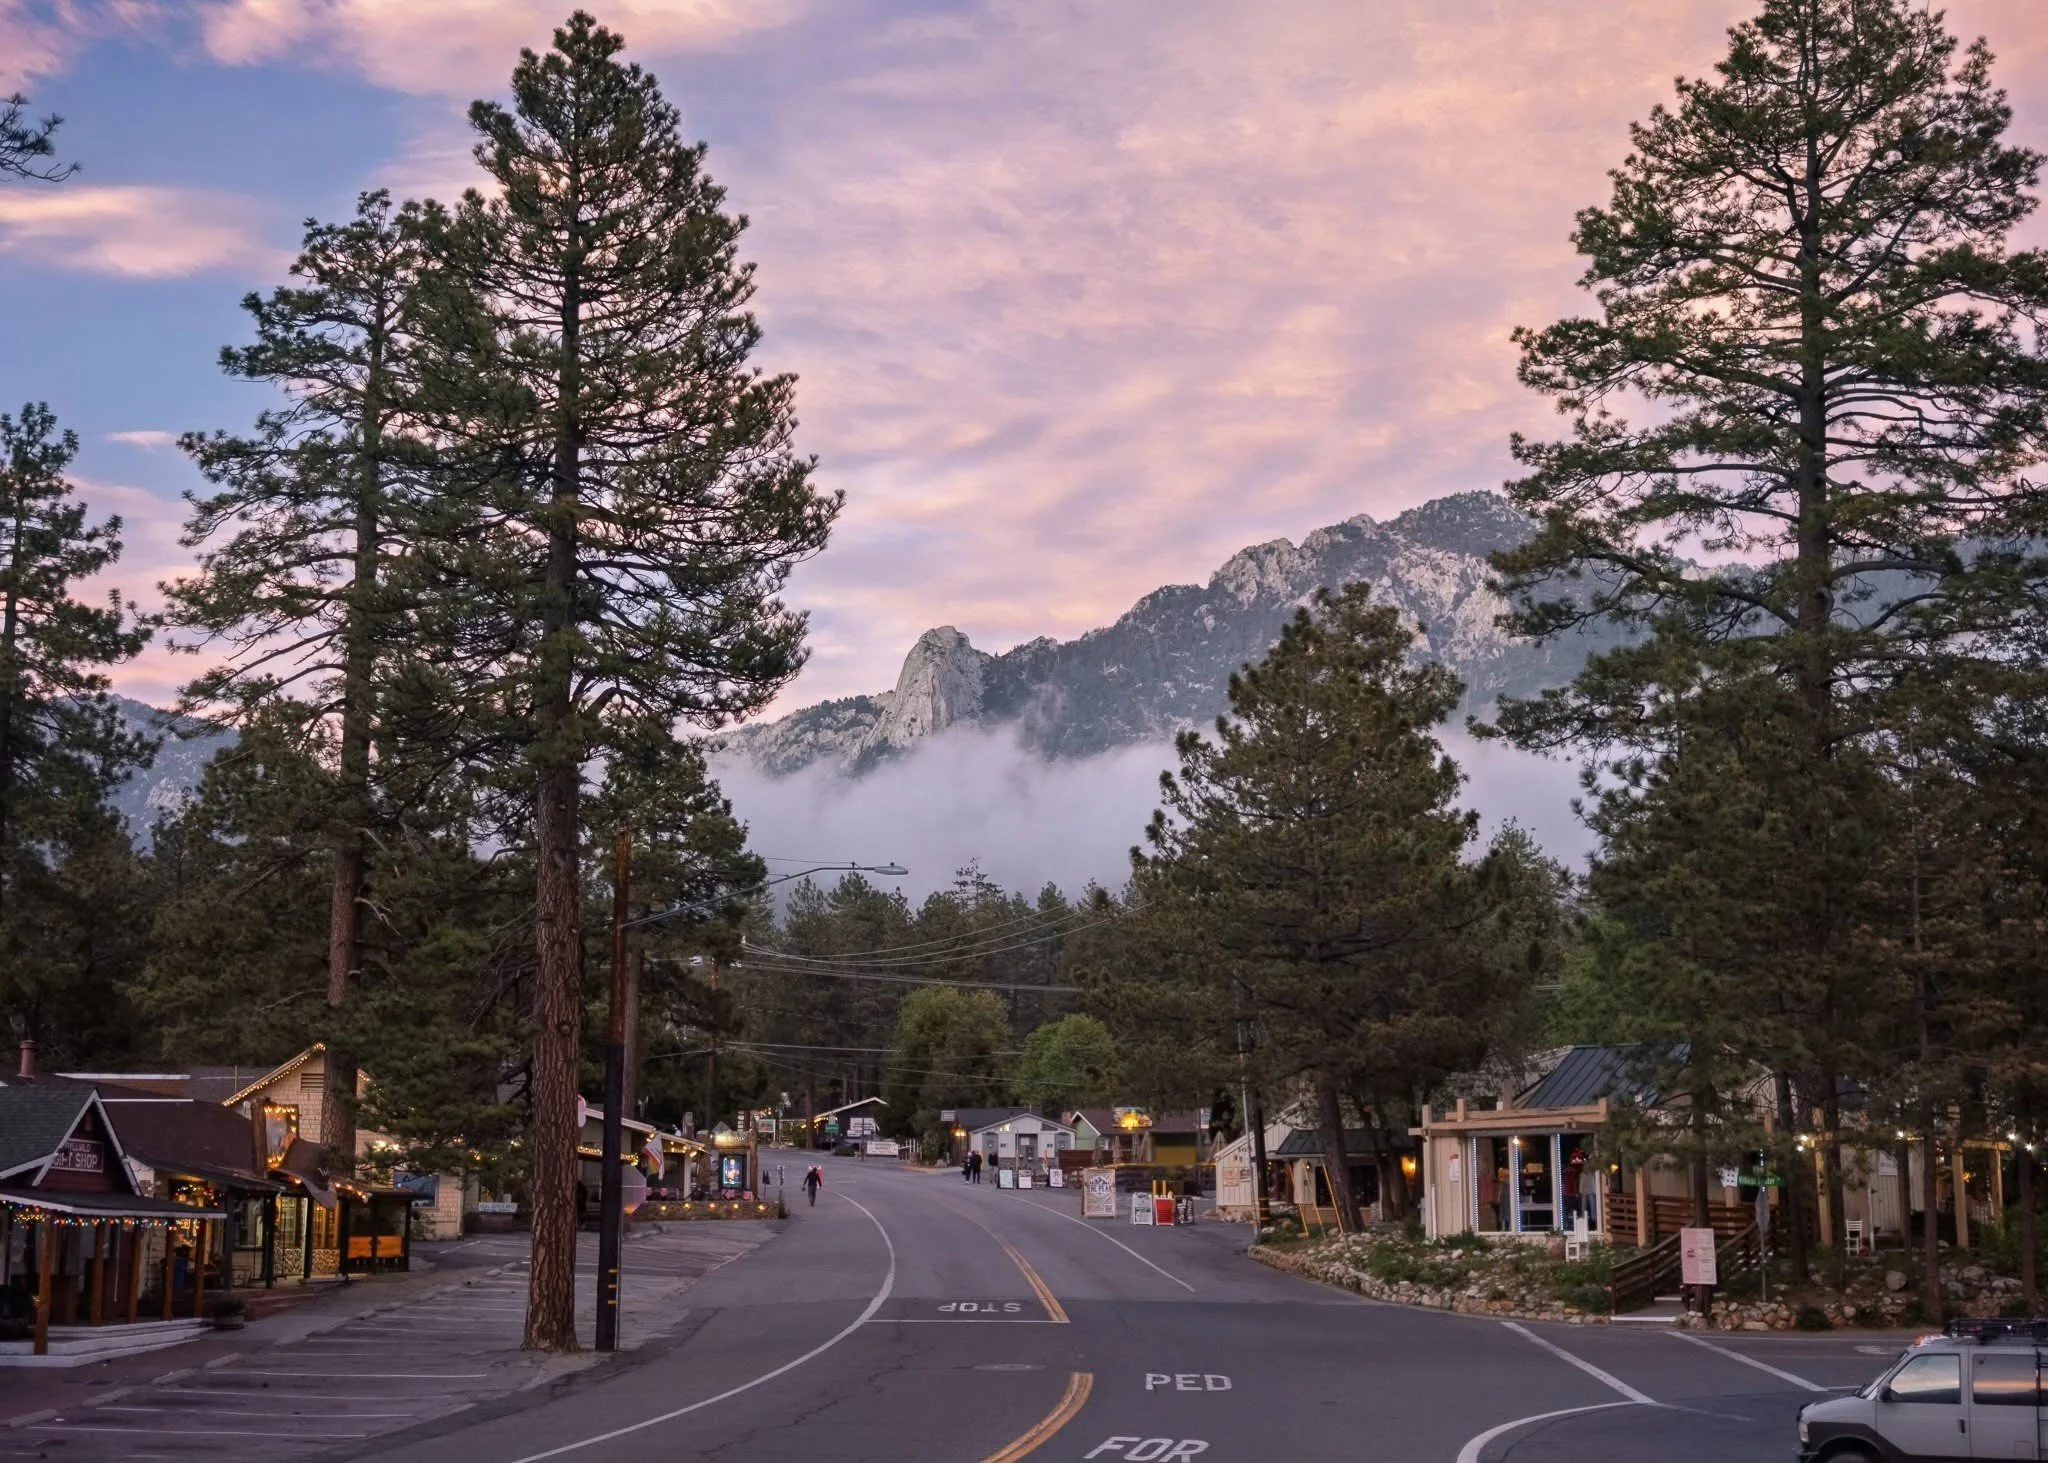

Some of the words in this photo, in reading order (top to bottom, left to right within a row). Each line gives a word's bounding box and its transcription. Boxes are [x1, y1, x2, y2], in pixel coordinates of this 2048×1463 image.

[75, 1152, 97, 1168] SHOP
[937, 1302, 1022, 1313] STOP
[1145, 1373, 1232, 1391] PED
[1082, 1436, 1210, 1463] FOR
